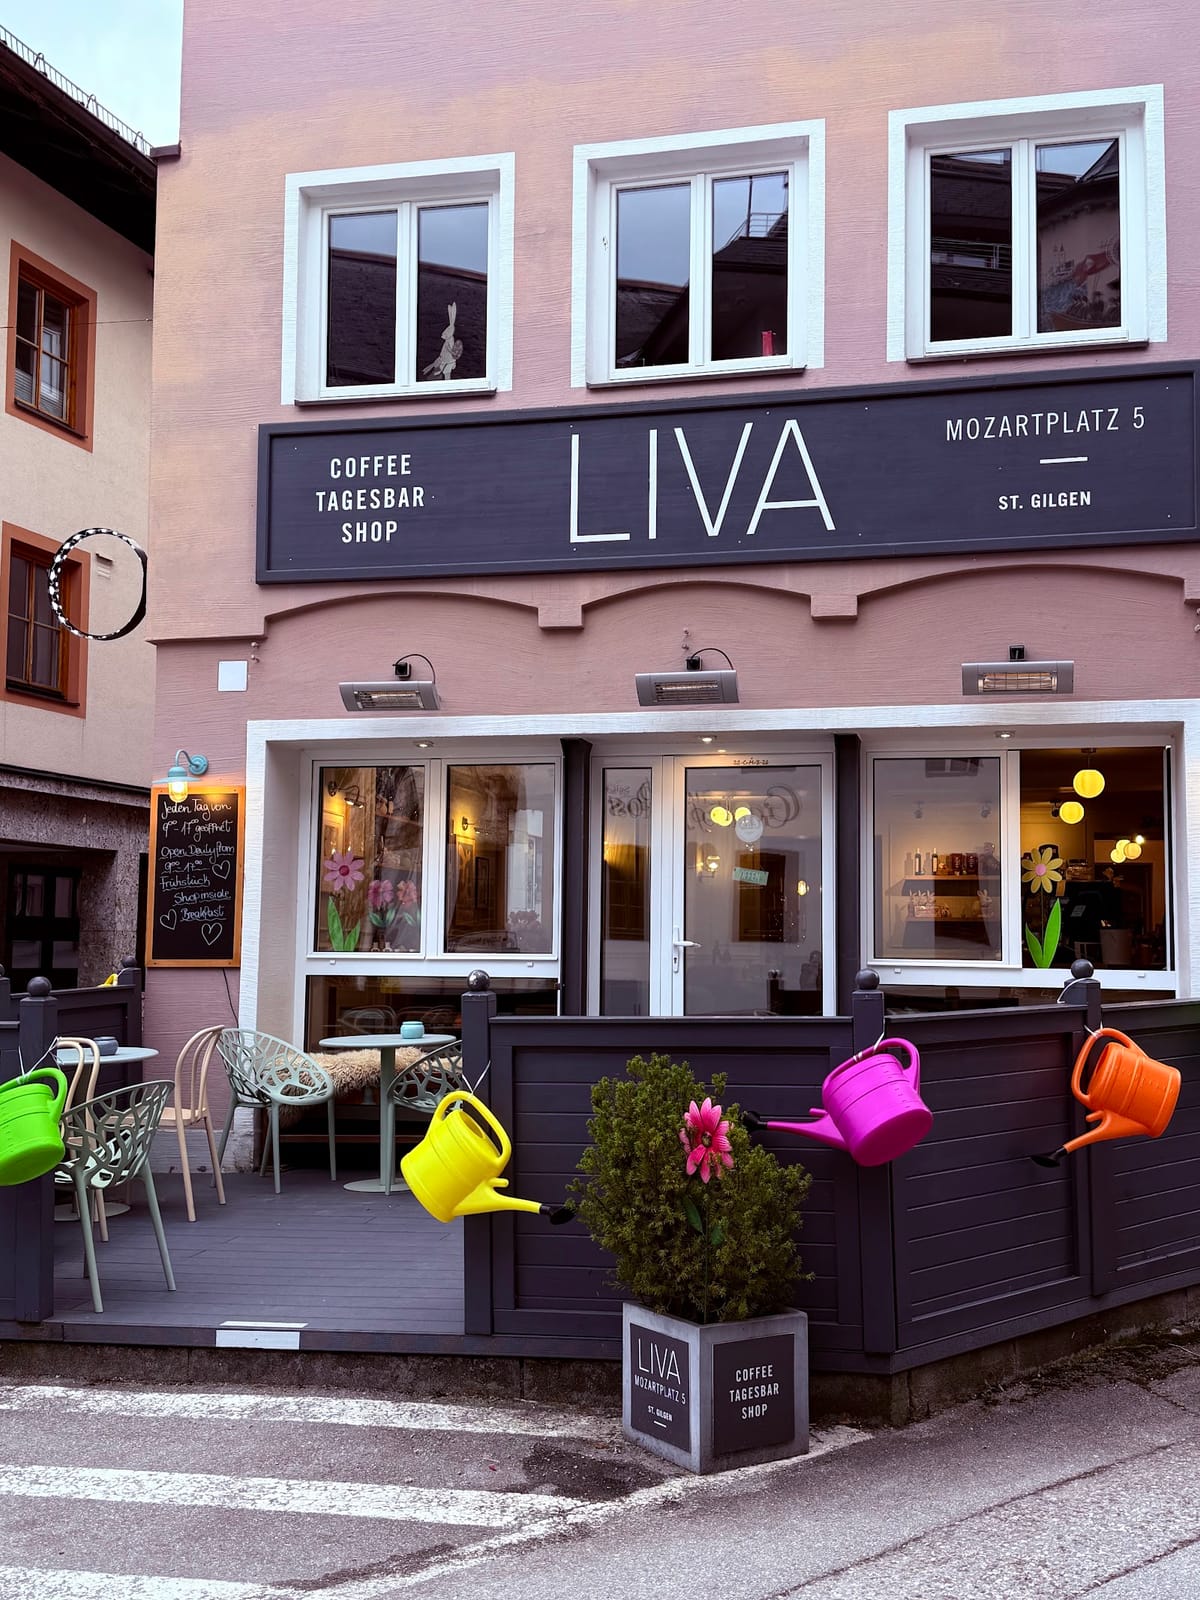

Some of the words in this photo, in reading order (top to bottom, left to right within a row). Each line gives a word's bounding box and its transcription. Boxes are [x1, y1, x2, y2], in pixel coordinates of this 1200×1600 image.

[946, 408, 1119, 441] MOZARTPLATZ
[1133, 407, 1145, 429] 5
[330, 454, 412, 479] COFFEE
[569, 419, 836, 544] LIVA
[316, 486, 425, 512] TAGESBAR
[998, 494, 1023, 510] ST.
[1030, 490, 1091, 509] GILGEN
[341, 520, 398, 544] SHOP
[161, 801, 191, 819] Jeden
[191, 798, 210, 821] Tag
[210, 803, 231, 812] von
[193, 819, 233, 842] geöffnet
[161, 846, 186, 859] Open
[160, 873, 211, 889] Frühstück
[174, 891, 200, 904] Shop
[200, 888, 230, 899] inside
[180, 905, 225, 920] Breakfast
[638, 1338, 681, 1385] LIVA
[735, 1364, 773, 1383] COFFEE
[634, 1374, 680, 1402] MOZARTPLATZ
[681, 1392, 686, 1405] 5
[729, 1382, 779, 1402] TAGESBAR
[647, 1405, 655, 1415] ST.
[656, 1409, 673, 1422] GILGEN
[741, 1403, 768, 1420] SHOP
